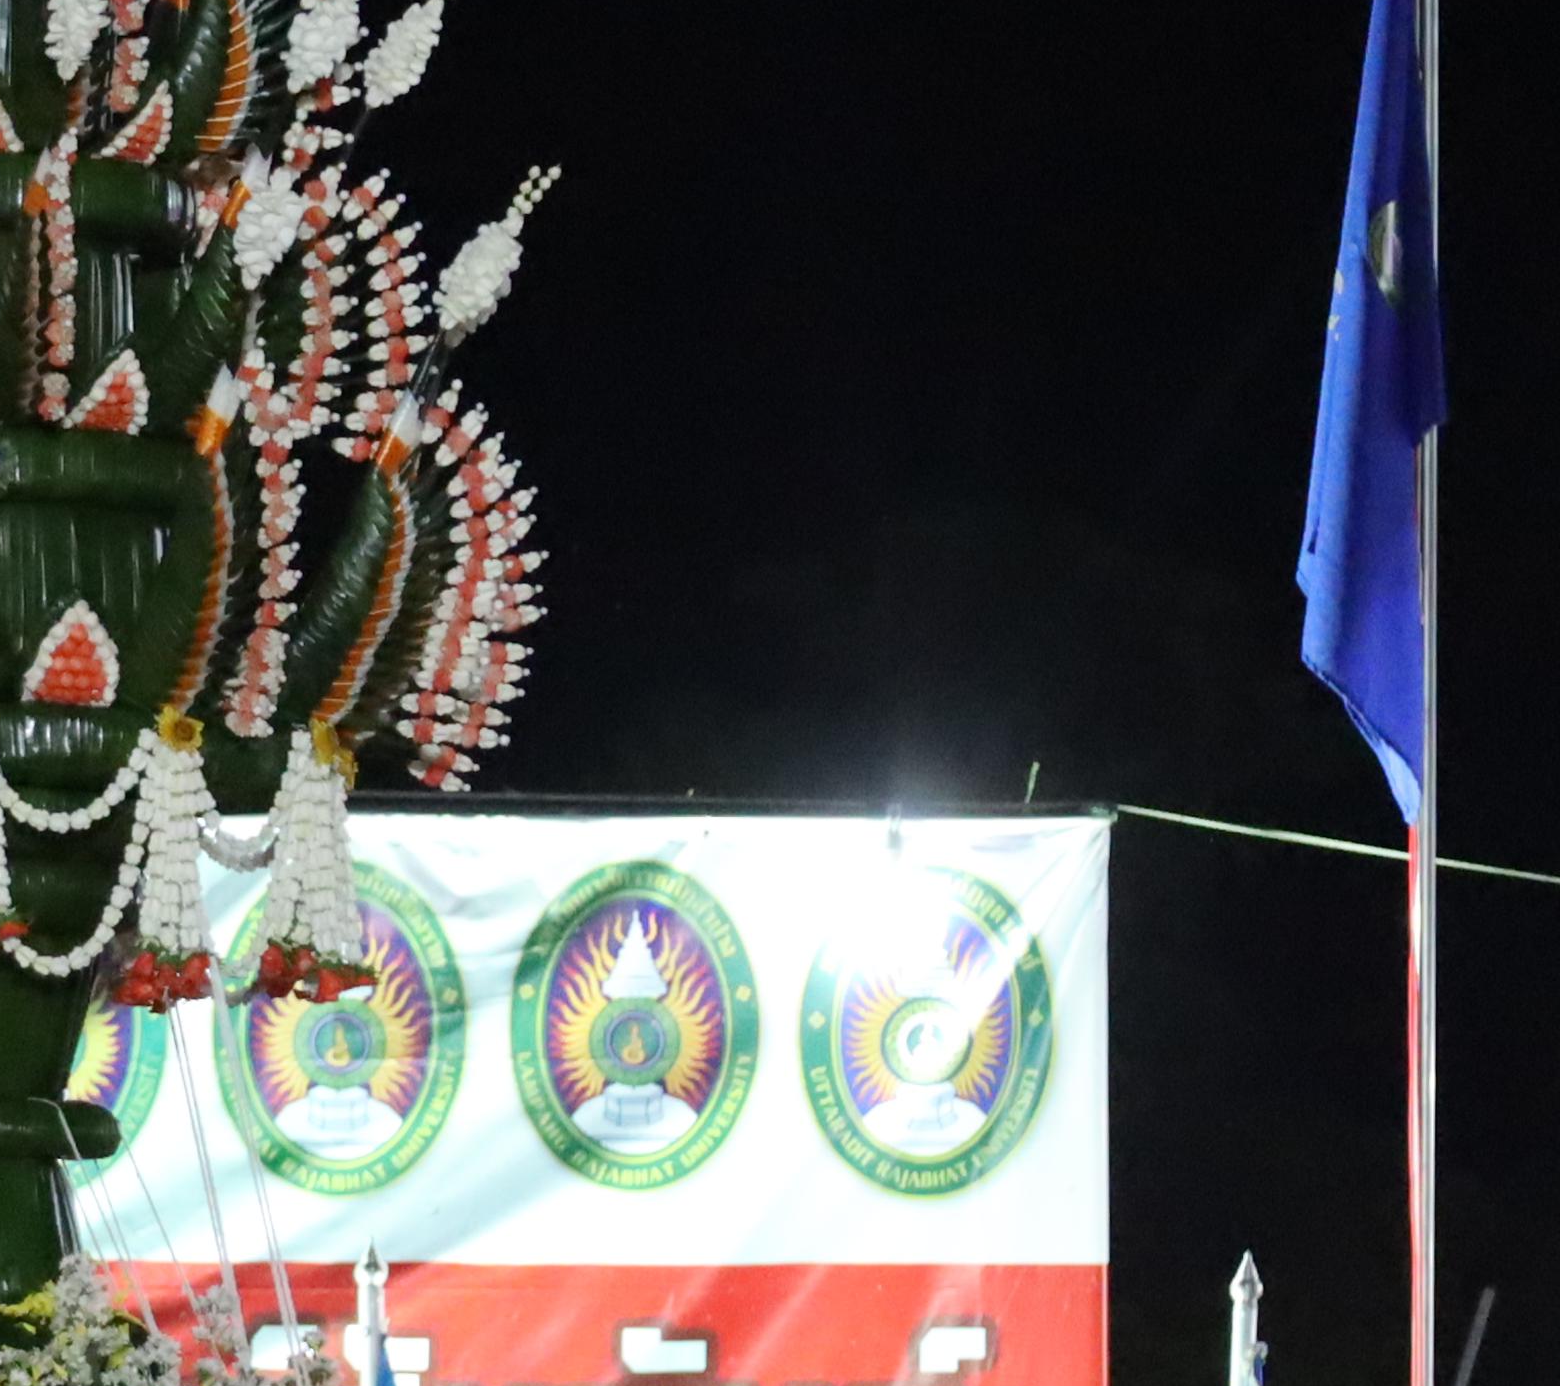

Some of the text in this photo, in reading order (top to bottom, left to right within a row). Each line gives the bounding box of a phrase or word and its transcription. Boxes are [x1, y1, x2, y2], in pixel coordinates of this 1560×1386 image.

[678, 1052, 753, 1171] UNIVERSITY
[806, 1064, 877, 1171] UTTARADIT
[873, 1153, 970, 1193] RAJABHAT
